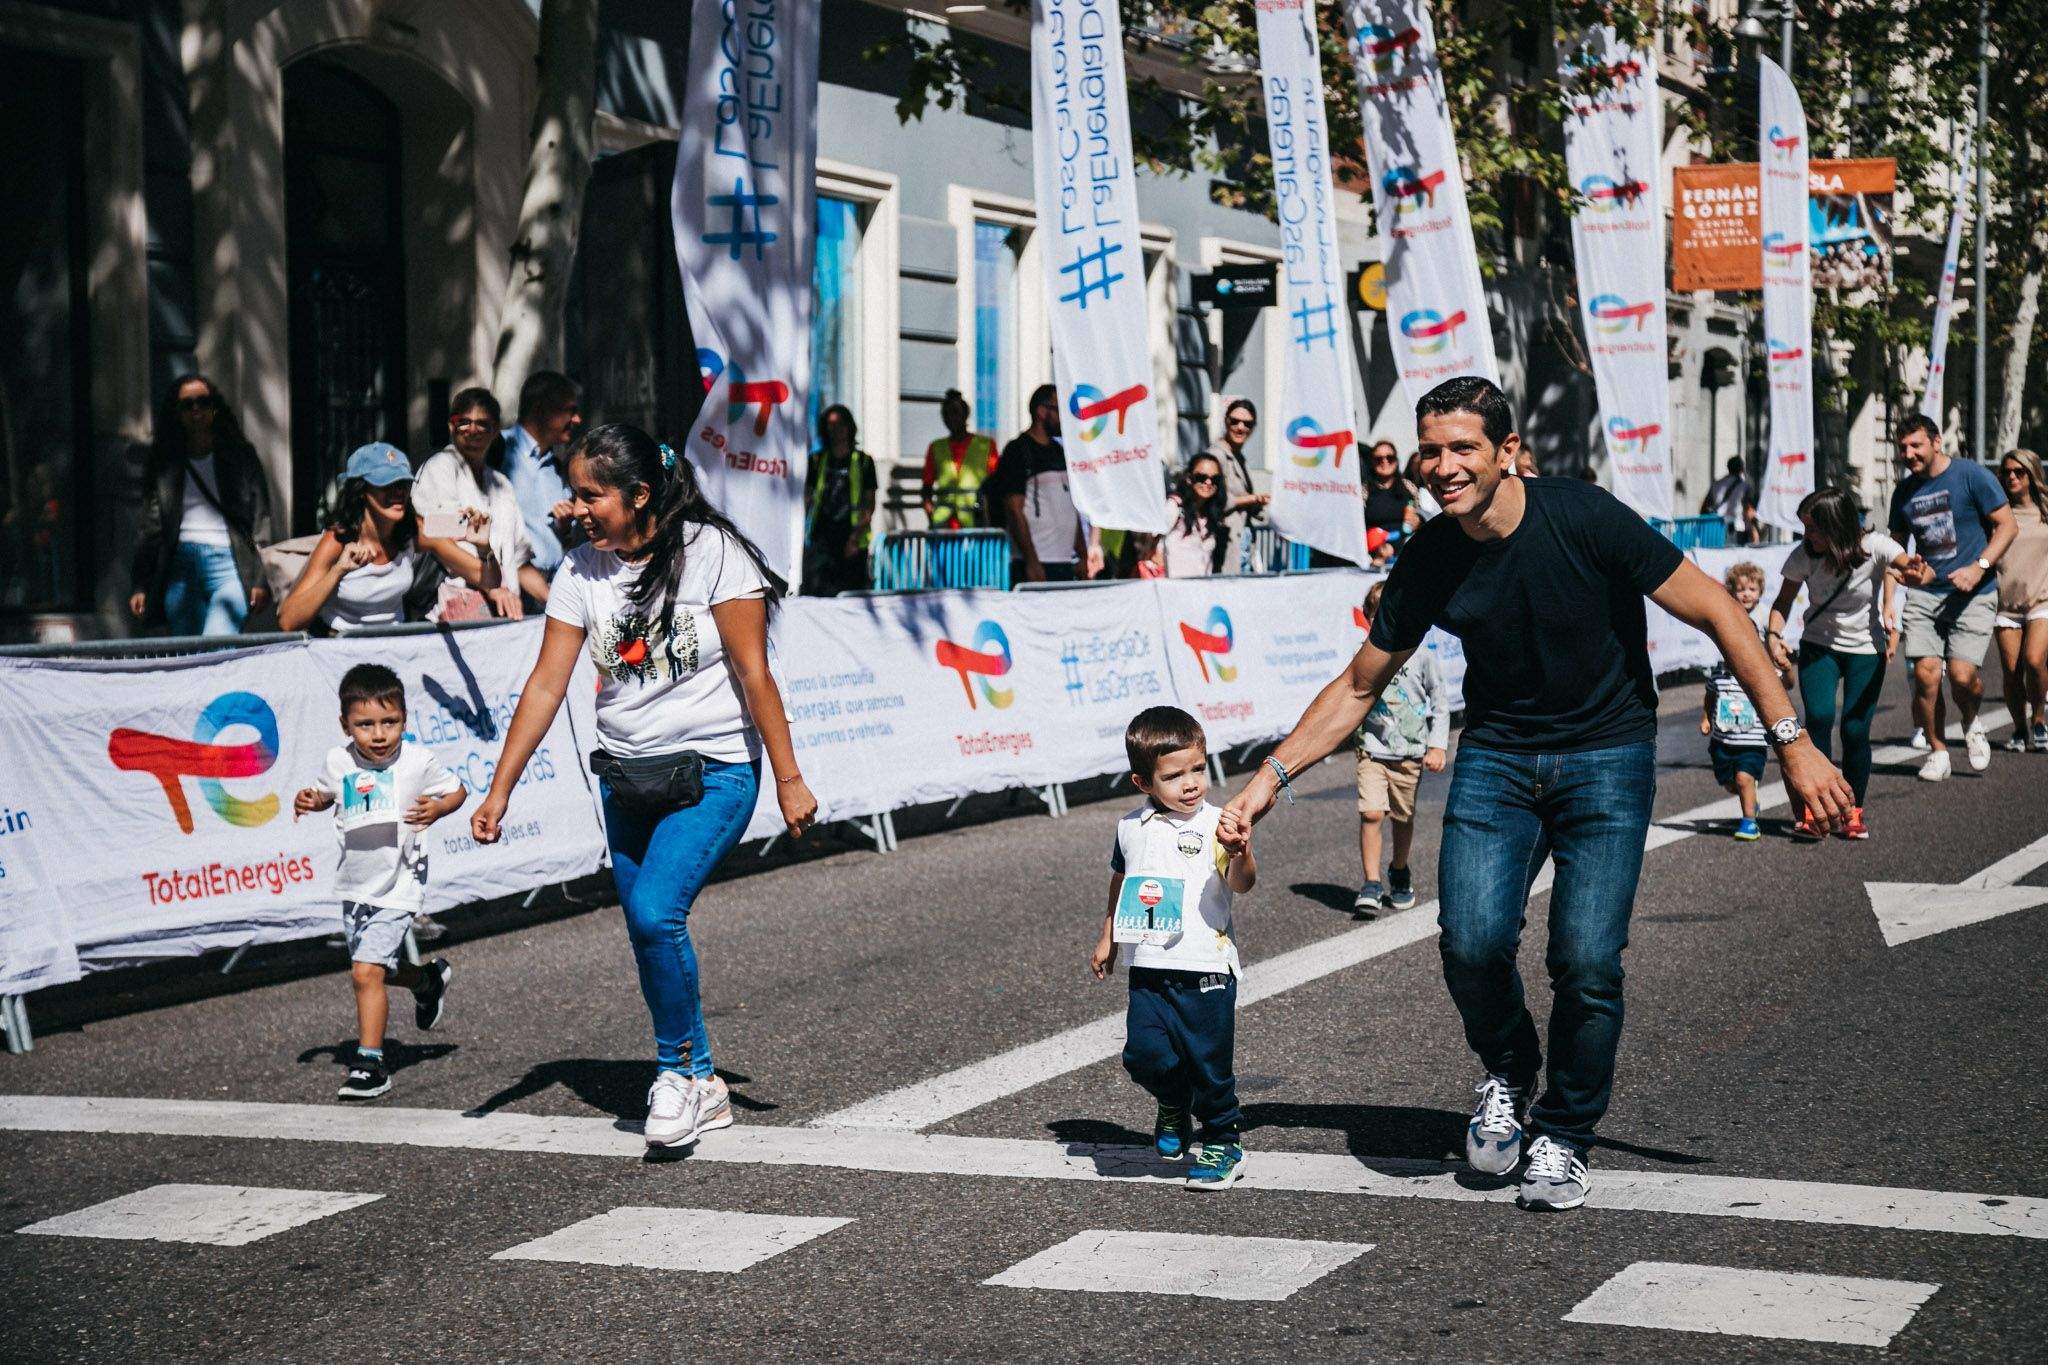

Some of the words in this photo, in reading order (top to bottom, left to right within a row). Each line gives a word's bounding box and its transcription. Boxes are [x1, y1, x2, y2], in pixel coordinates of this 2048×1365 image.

[363, 793, 370, 811] 1
[142, 853, 313, 905] TotalEnergies
[1145, 907, 1154, 930] 1
